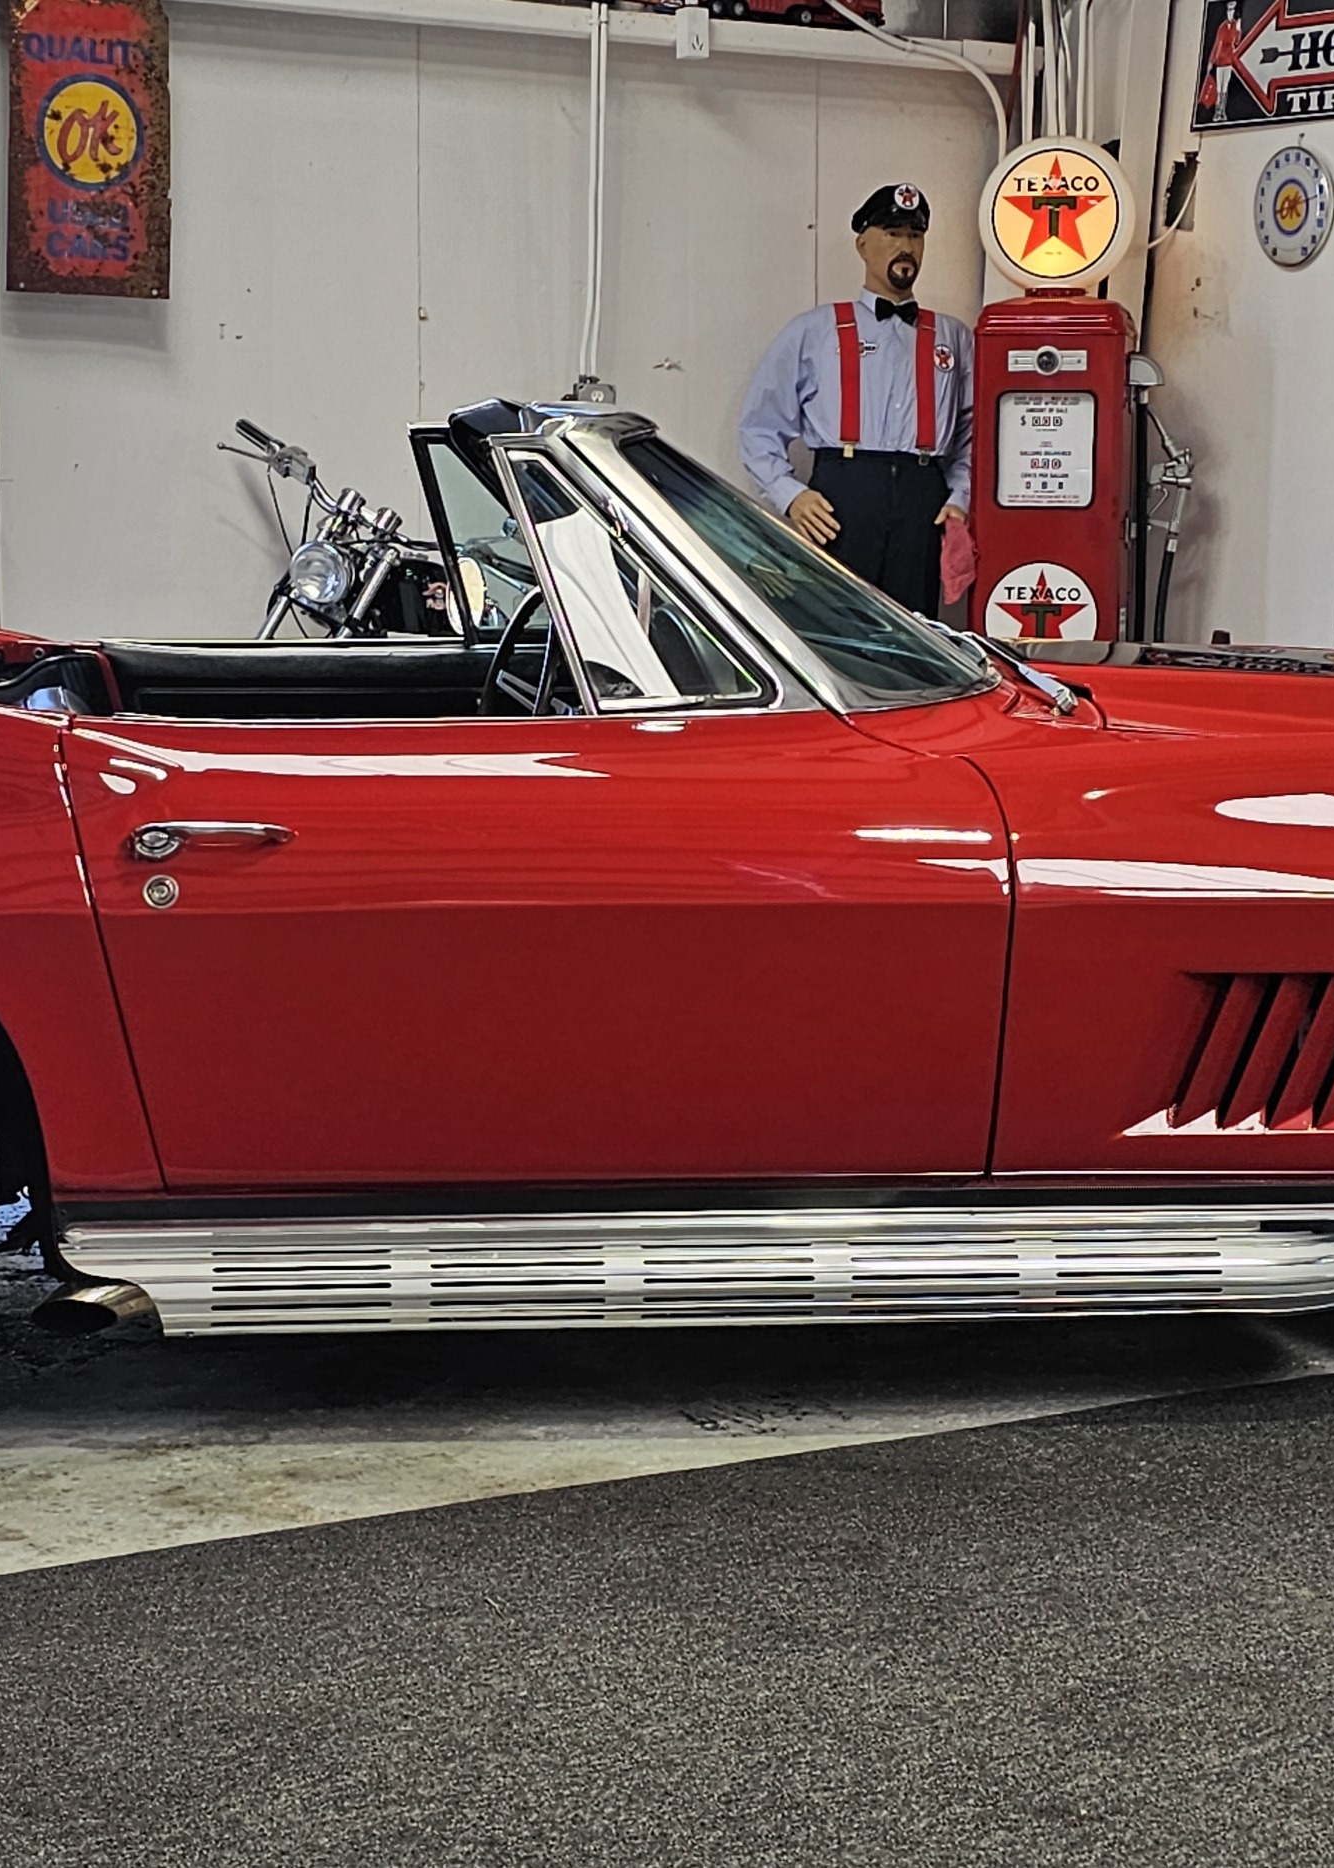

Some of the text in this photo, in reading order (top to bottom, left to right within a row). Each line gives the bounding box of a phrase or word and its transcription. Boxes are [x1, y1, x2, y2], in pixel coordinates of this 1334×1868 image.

[57, 100, 123, 163] OK
[1013, 175, 1100, 193] TEXACO
[1003, 586, 1081, 602] TEXACO
